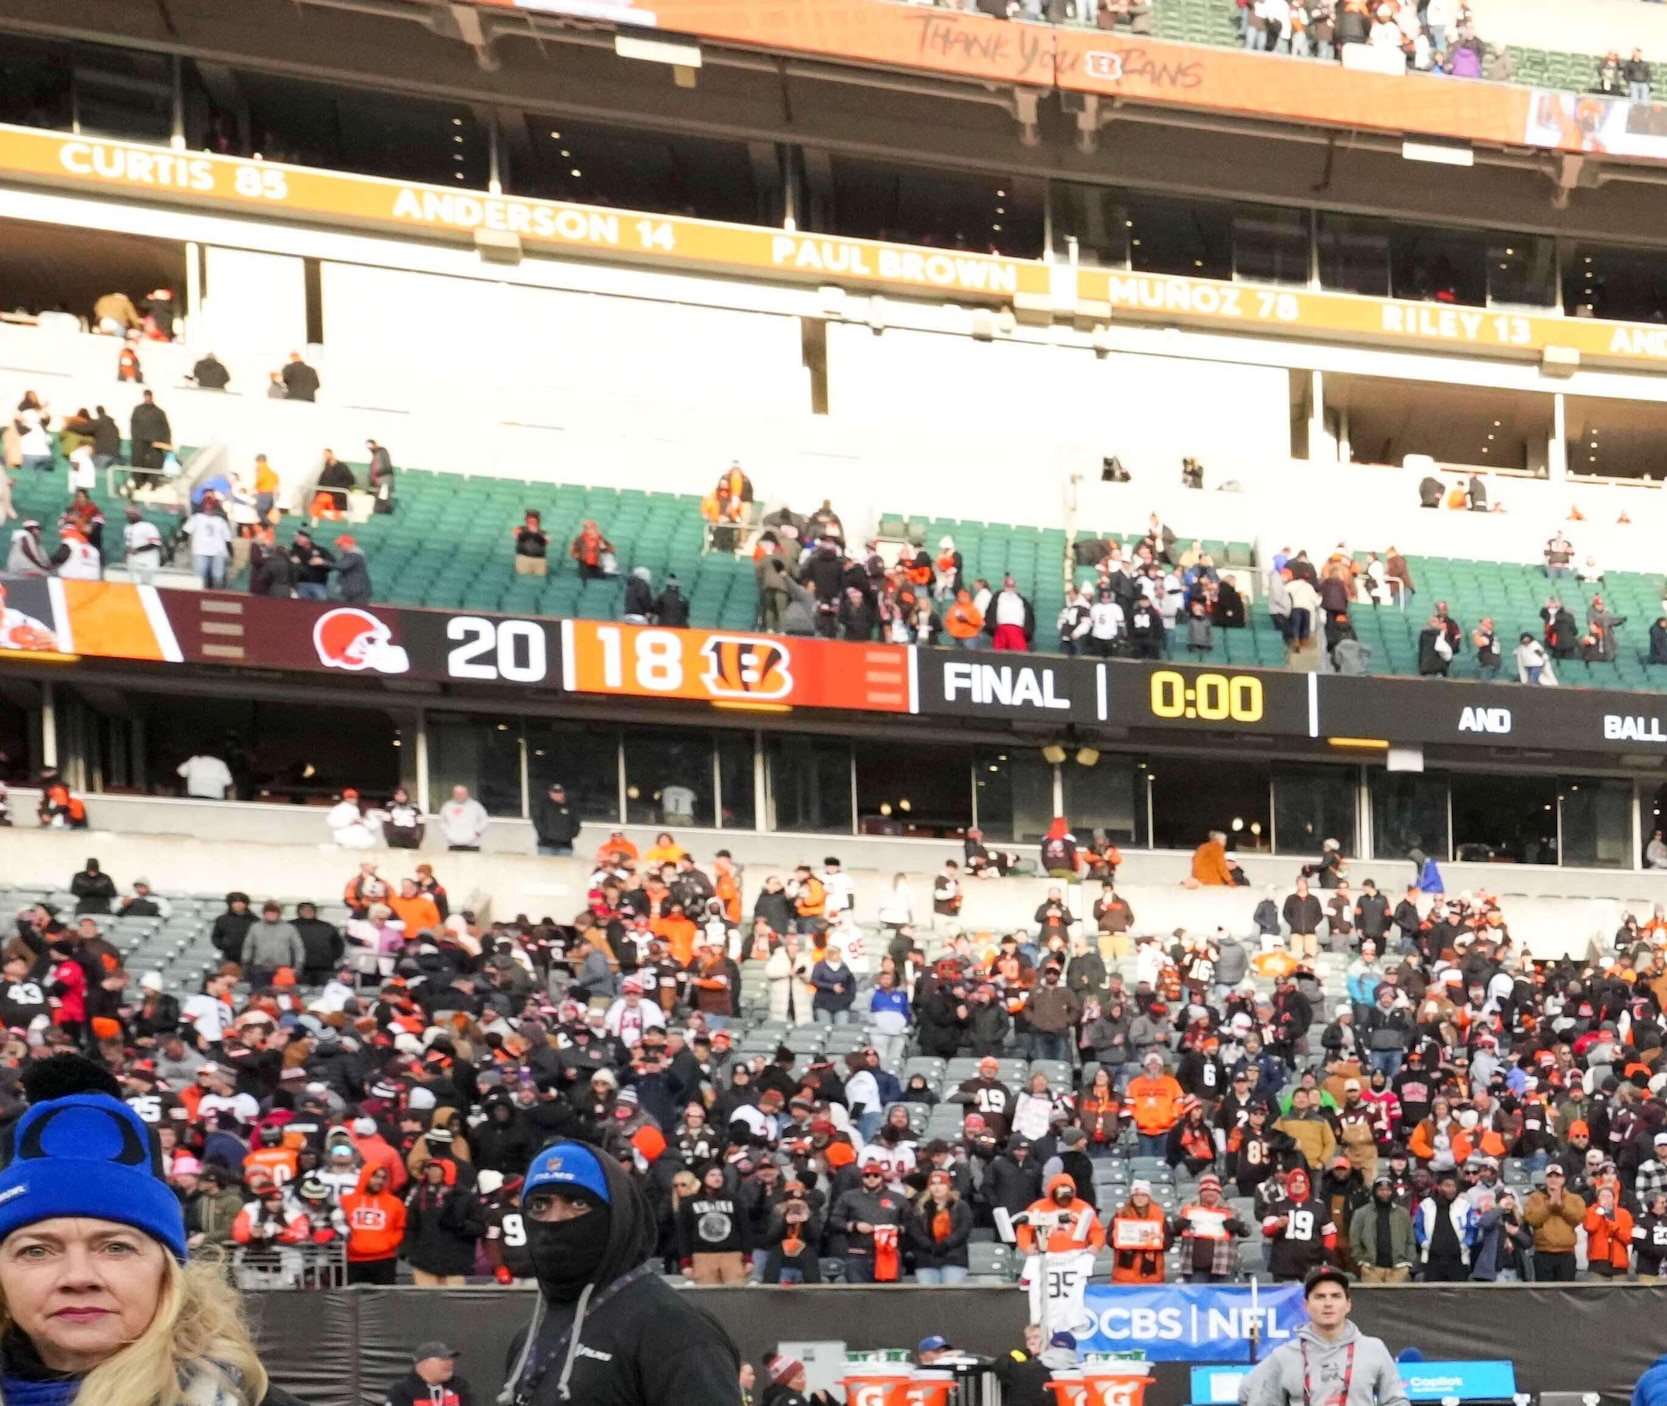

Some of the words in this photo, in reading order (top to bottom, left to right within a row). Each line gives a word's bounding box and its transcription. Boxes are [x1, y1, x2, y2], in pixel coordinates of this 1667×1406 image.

[60, 139, 213, 191] CURTIS
[234, 166, 288, 201] 85
[394, 187, 619, 246] ANDERSON
[636, 220, 675, 251] 14
[772, 235, 869, 277] PAUL
[878, 251, 1016, 293] BROWN
[1258, 292, 1300, 321] 78
[1382, 305, 1481, 340] RILEY
[1494, 318, 1531, 346] 13
[447, 617, 547, 683] 20
[596, 626, 682, 691] 18
[944, 662, 1070, 709] FINAL
[1150, 670, 1263, 721] 0:00
[1458, 706, 1511, 734] AND
[1603, 714, 1667, 741] BALL
[978, 1088, 1005, 1113] 19
[1285, 1210, 1314, 1240] 19
[1099, 1307, 1182, 1340] CBS
[1208, 1306, 1289, 1339] NFL
[1410, 1376, 1464, 1389] Copilot
